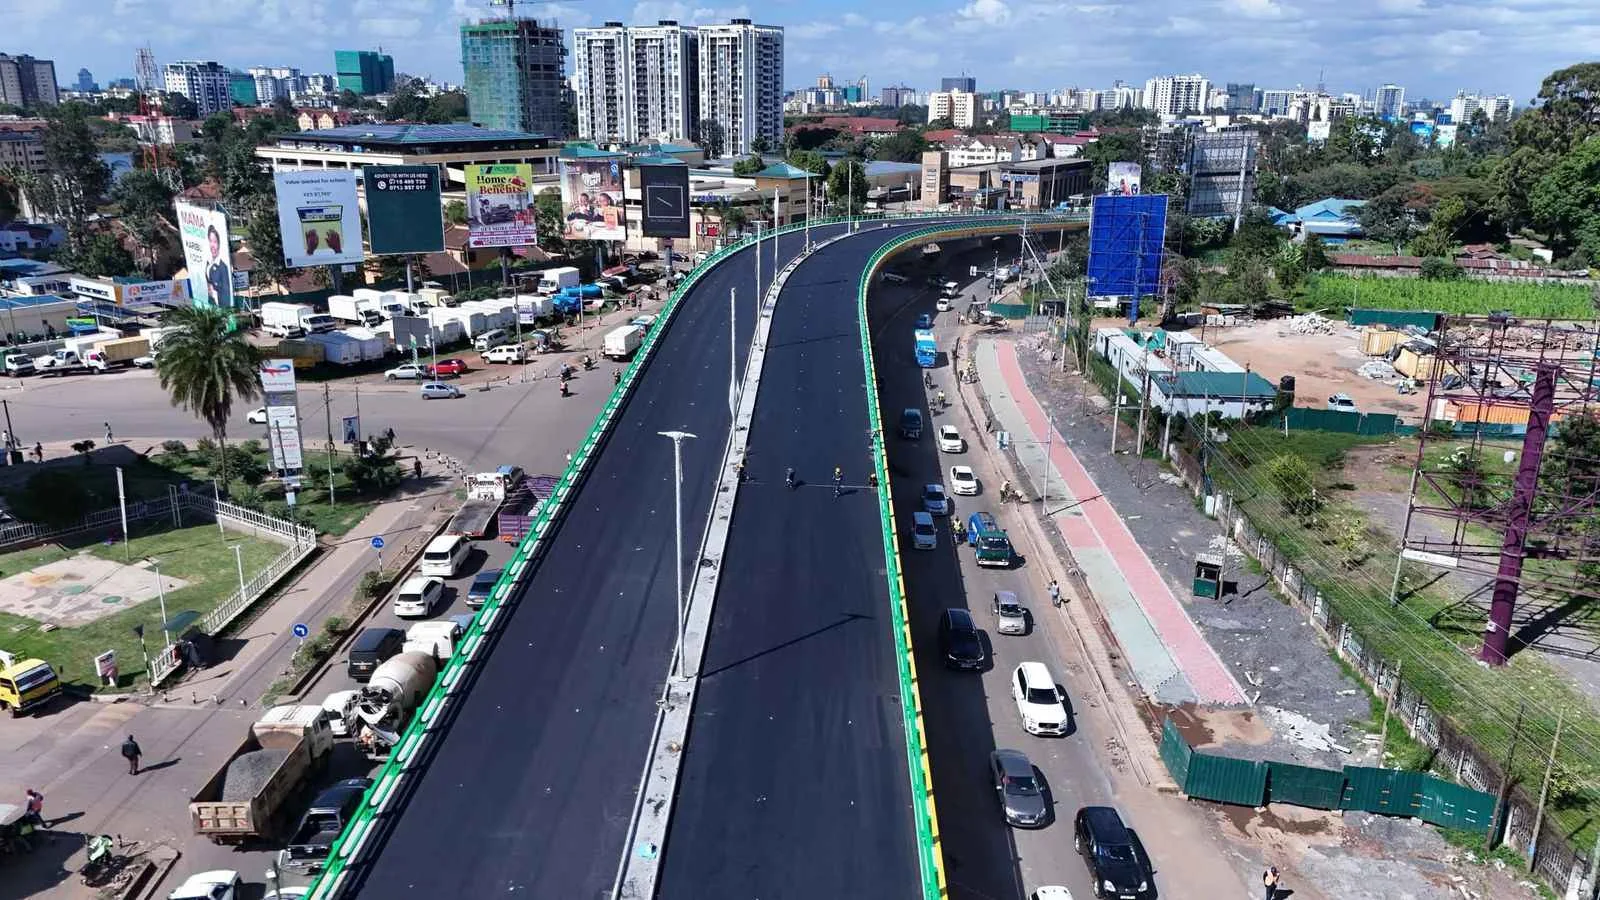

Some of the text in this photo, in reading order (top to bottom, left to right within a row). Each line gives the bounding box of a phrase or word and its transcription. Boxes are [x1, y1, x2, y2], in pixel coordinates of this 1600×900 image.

[476, 176, 507, 184] Home
[480, 185, 523, 194] Benefits
[180, 210, 206, 228] MAMA
